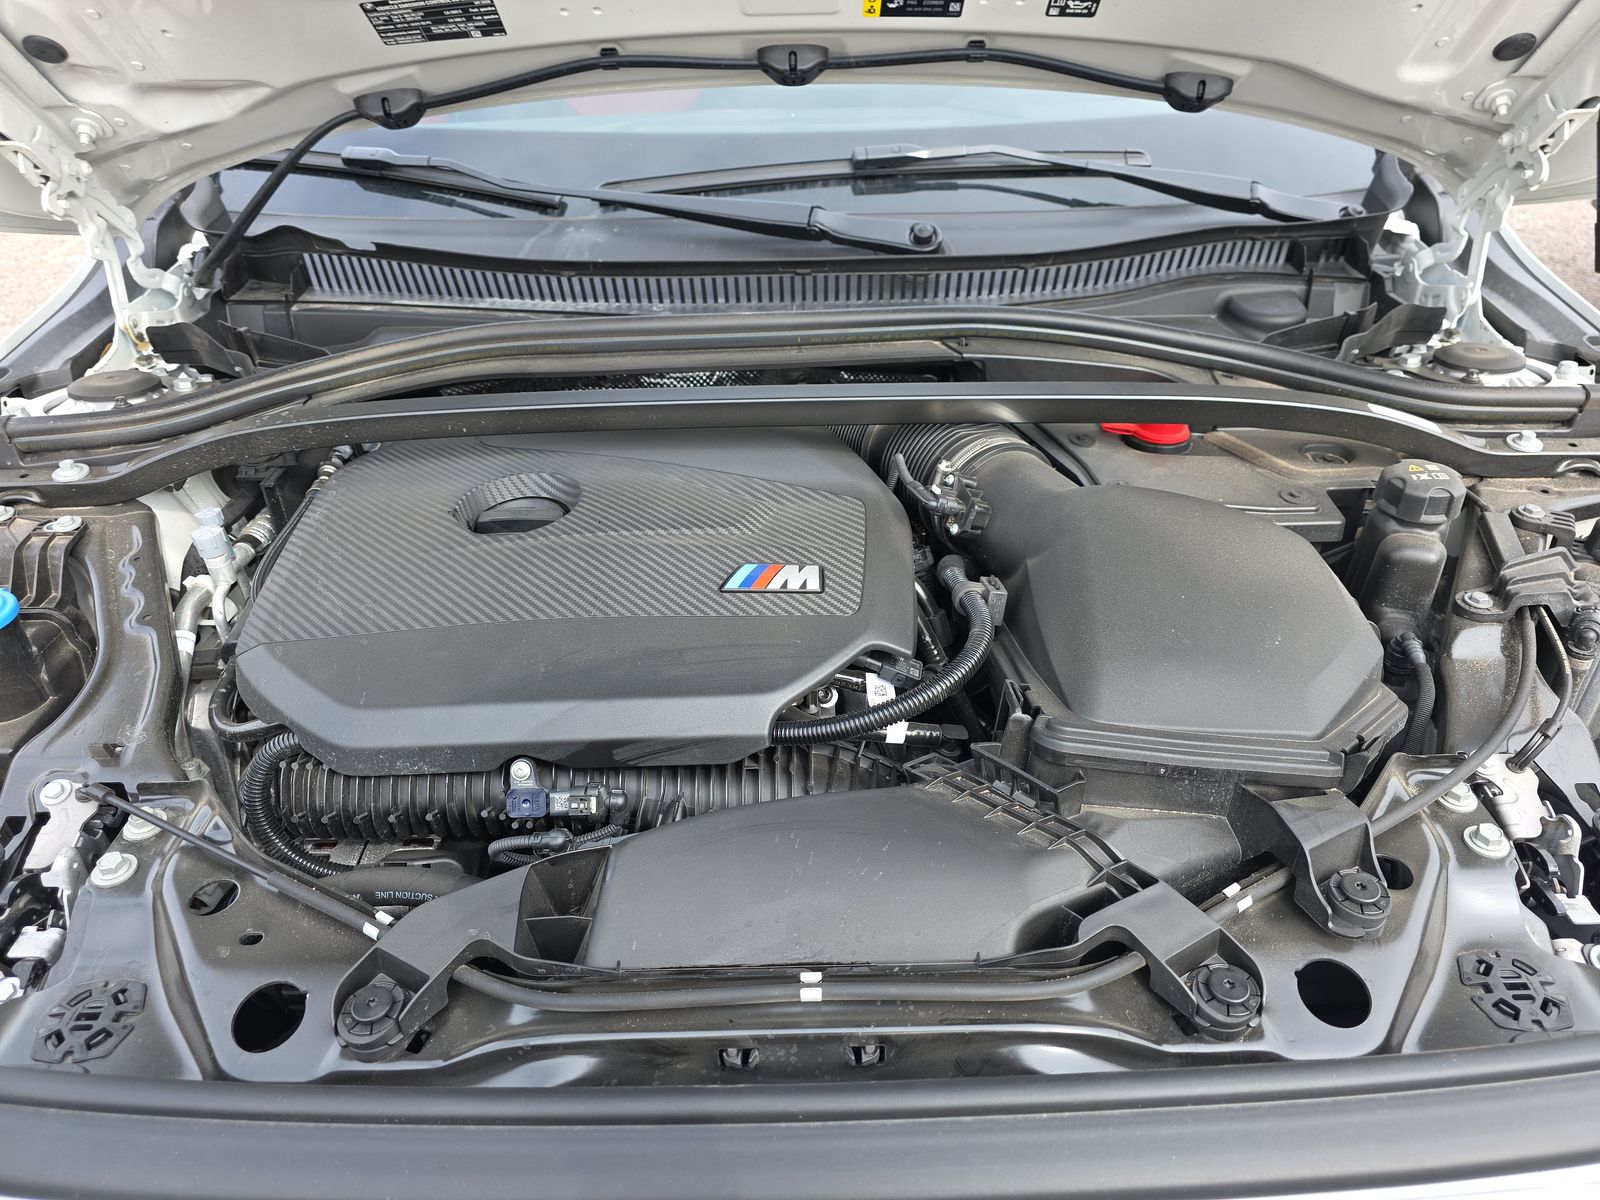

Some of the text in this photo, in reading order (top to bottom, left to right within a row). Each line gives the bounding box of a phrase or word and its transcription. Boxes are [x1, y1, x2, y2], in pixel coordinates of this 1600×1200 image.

[765, 564, 820, 590] M
[375, 891, 394, 899] LINE
[395, 891, 433, 900] SUCTION
